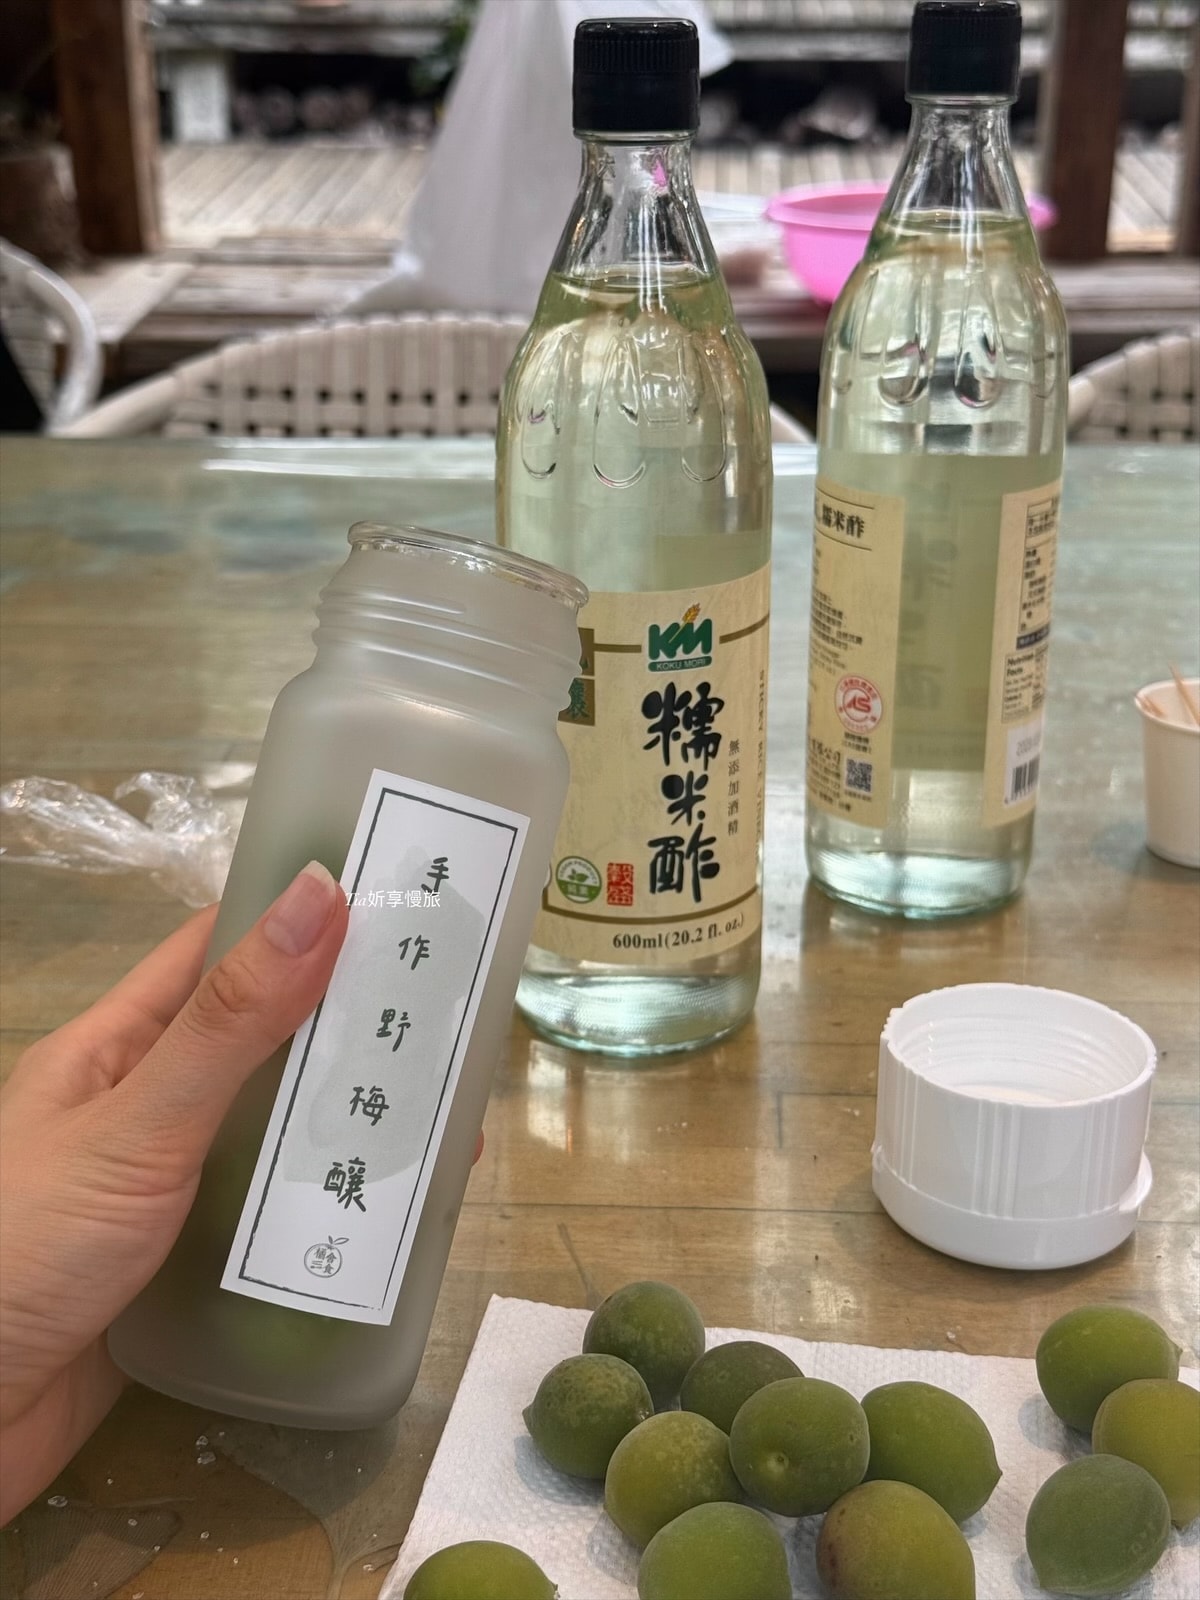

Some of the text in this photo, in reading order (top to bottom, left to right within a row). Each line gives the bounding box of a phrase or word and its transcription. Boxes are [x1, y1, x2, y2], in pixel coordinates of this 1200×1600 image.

[648, 618, 713, 661] KM
[656, 657, 706, 671] KOKU MORI
[641, 681, 725, 902] 糯米酢
[727, 739, 741, 837] 無添加酒精
[612, 928, 703, 949] 600ml(20.2
[708, 923, 722, 939] fl.
[322, 856, 450, 1212] 手作野梅釀
